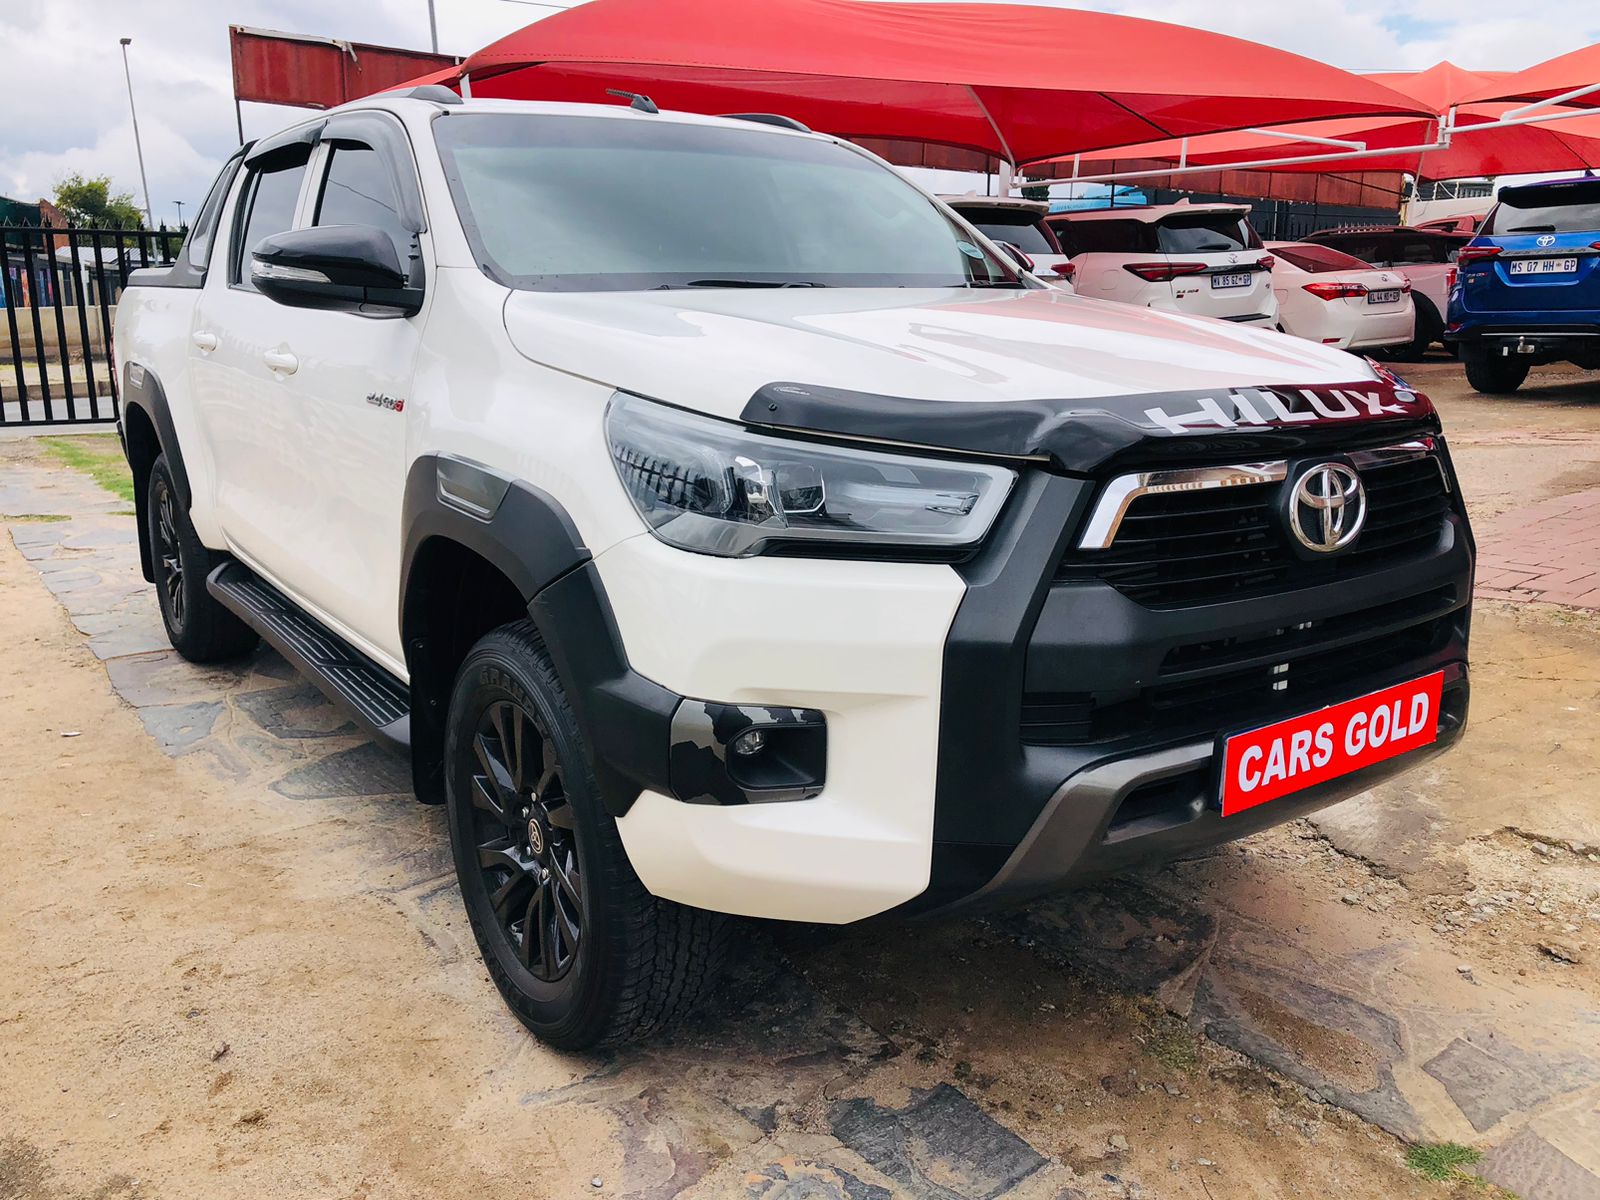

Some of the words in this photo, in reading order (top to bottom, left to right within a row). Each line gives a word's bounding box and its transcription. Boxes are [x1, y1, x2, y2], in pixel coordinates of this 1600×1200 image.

[1511, 262, 1523, 273] MS
[1527, 261, 1539, 272] 07
[1542, 260, 1555, 271] HH
[1564, 260, 1576, 271] GP
[1144, 389, 1408, 434] HILUX
[1238, 722, 1334, 793] CARS
[1344, 691, 1430, 757] GOLD
